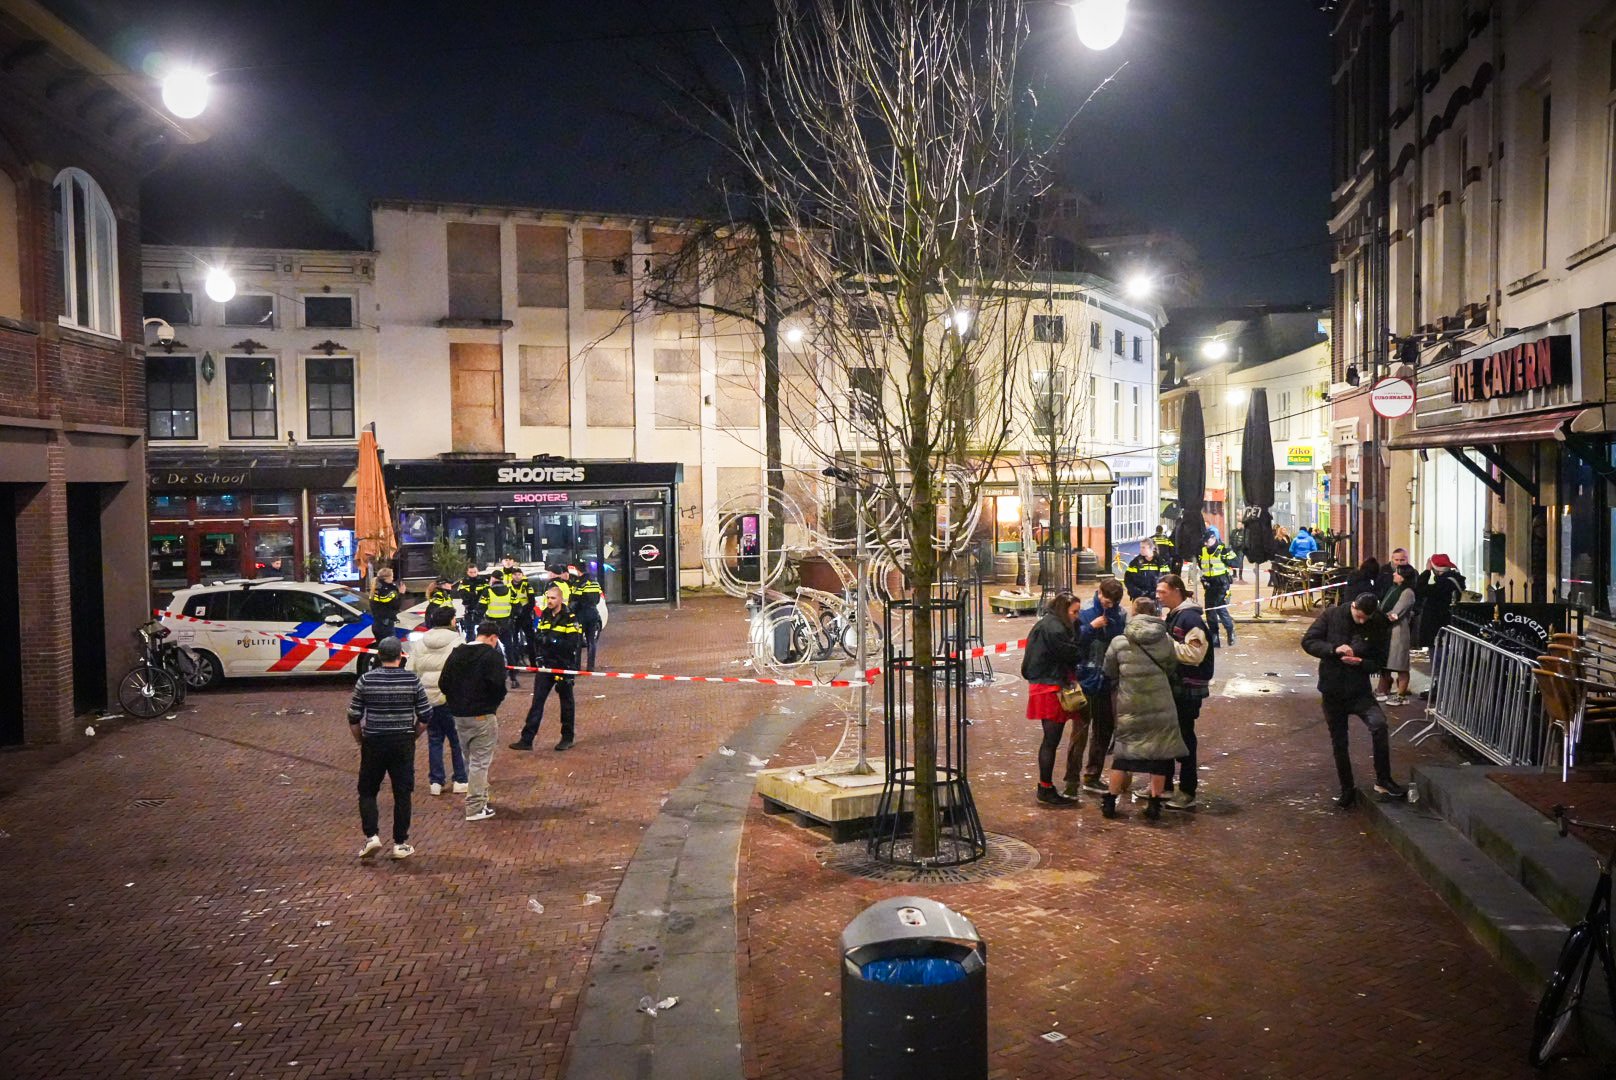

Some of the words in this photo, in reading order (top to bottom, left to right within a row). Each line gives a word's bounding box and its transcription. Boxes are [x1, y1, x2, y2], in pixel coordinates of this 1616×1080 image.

[1450, 361, 1475, 403] THE
[1482, 336, 1552, 400] CAVERN
[1289, 447, 1310, 455] Ziko
[167, 472, 188, 484] De
[497, 467, 585, 482] SHOOTERS
[513, 493, 568, 502] SHOOTERS
[1503, 612, 1547, 639] Cavern
[237, 637, 276, 648] POLITIE
